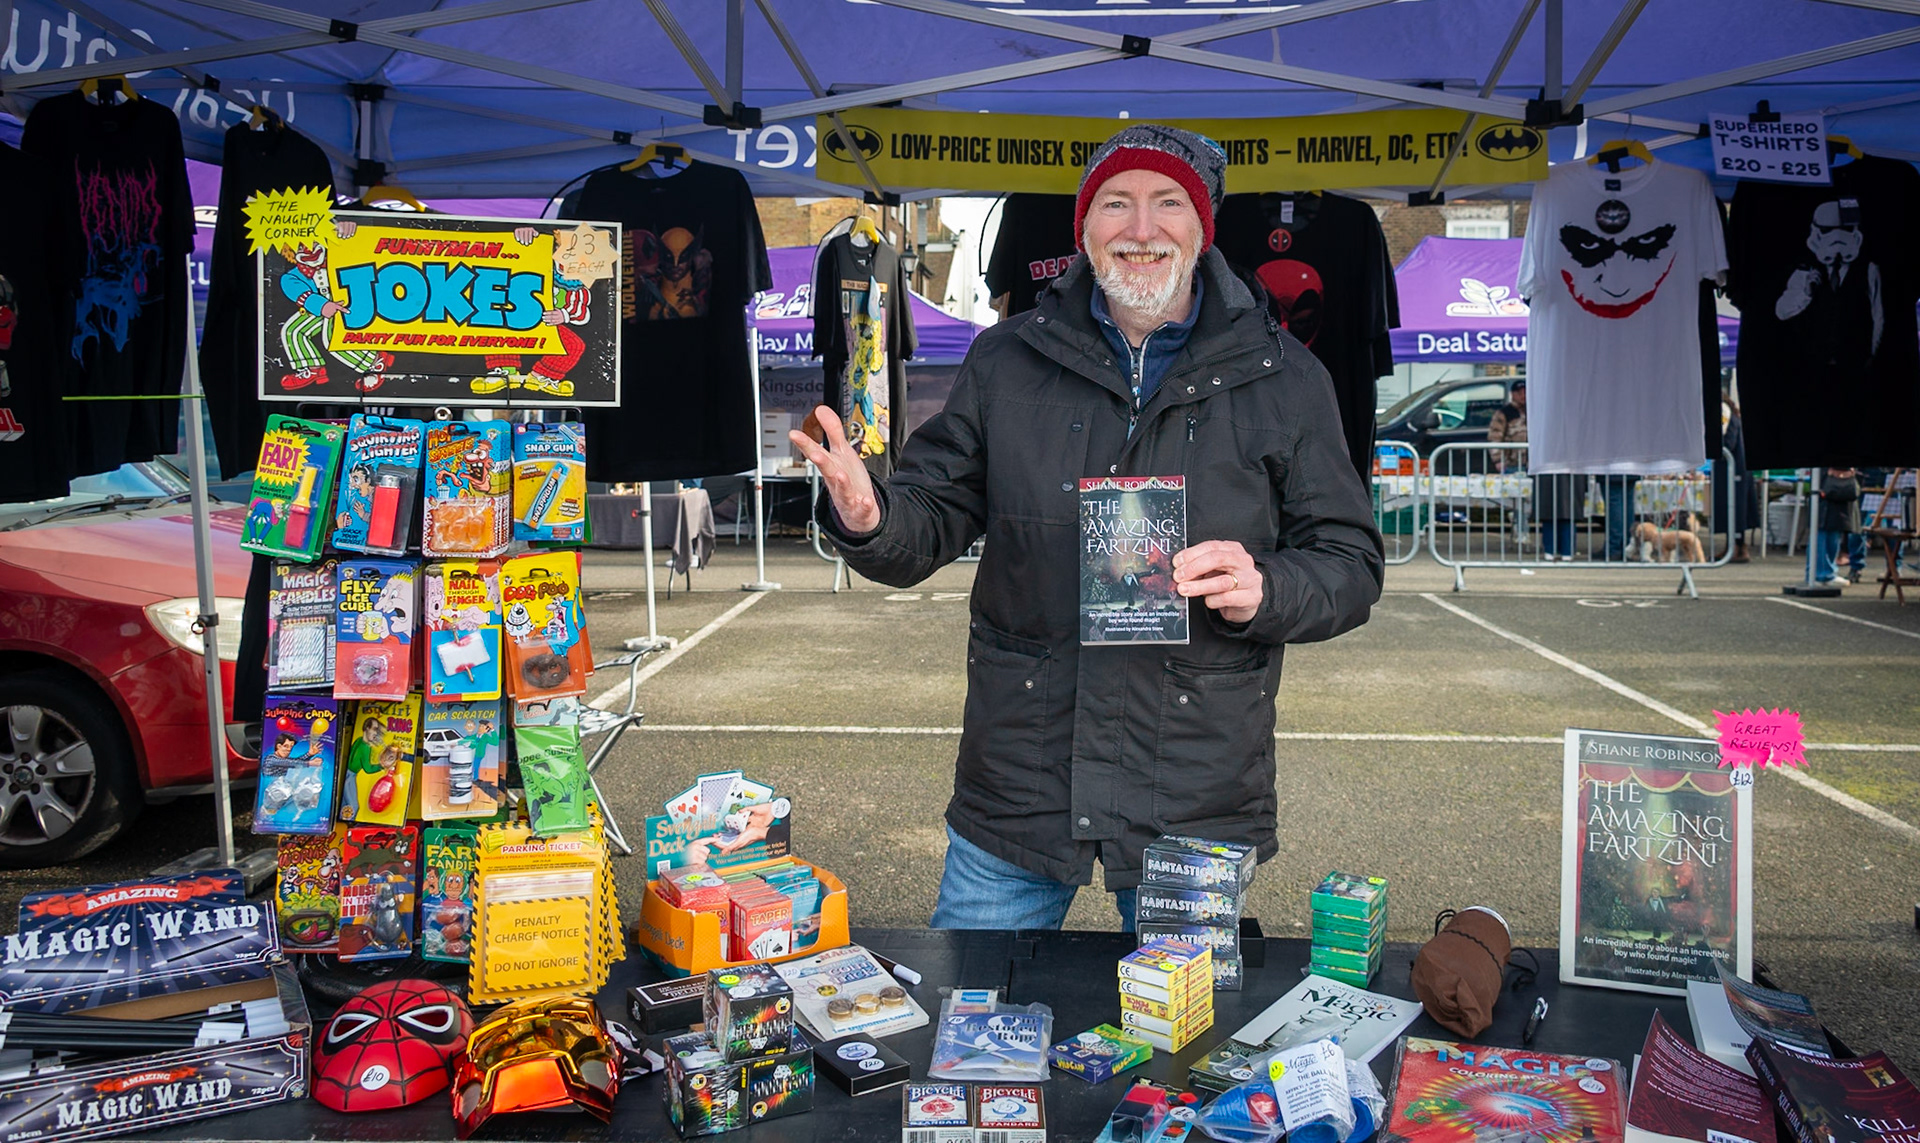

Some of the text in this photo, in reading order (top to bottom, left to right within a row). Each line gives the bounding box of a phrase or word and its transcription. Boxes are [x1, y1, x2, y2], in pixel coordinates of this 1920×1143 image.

[1714, 119, 1818, 134] SUPERHERO
[891, 133, 991, 163] LOW-PRICE
[997, 138, 1064, 166] UNISEX
[1297, 135, 1382, 165] MARVEL,
[1388, 134, 1419, 164] DC,
[1715, 133, 1820, 151] T-SHIRTS
[1721, 157, 1821, 176] £20 £25
[267, 201, 299, 212] THE
[260, 213, 326, 230] NAUGHTY
[265, 227, 319, 240] CORNER
[566, 261, 605, 274] EACH
[336, 262, 546, 331] JOKES
[342, 332, 537, 348] PARTY FUN FOR EVERYONE
[1417, 331, 1528, 354] Deal Satu
[276, 436, 293, 445] THE
[350, 427, 422, 452] SQUIRTING
[360, 443, 418, 461] LIGHTER
[428, 436, 475, 463] SWEETS
[525, 443, 575, 453] SNAP GUM
[261, 442, 303, 471] FART
[259, 466, 294, 479] WHISTLE
[1087, 480, 1179, 491] SHANE ROBINSON
[1084, 500, 1122, 515] THE
[1085, 517, 1181, 537] AMAZING
[1086, 537, 1171, 556] FARTZINI
[282, 571, 332, 589] MAGIC
[340, 579, 377, 594] FLY
[449, 579, 480, 590] NAIL
[277, 586, 337, 605] CANDLES
[346, 593, 370, 603] ICE
[503, 584, 538, 602] DOG
[538, 582, 570, 600] POO
[339, 602, 374, 612] CUBE
[446, 594, 486, 606] FINGER
[427, 710, 497, 722] CAR SCRATCH
[1734, 722, 1781, 735] GREAT
[1590, 742, 1641, 758] SHANE
[1730, 738, 1798, 756] REVIEWS!
[1732, 771, 1753, 786] £12
[1585, 778, 1643, 803] THE
[1587, 804, 1733, 843] AMAZING
[426, 845, 476, 860] FAR
[501, 842, 583, 853] PARKING TICKET
[649, 837, 686, 857] Deck
[1588, 832, 1718, 868] FARTZINI
[427, 858, 475, 871] CANDIE
[342, 884, 377, 897] MOUSE
[86, 887, 180, 911] AMAZING
[342, 897, 352, 905] IN
[342, 905, 371, 917] HOUS
[750, 907, 789, 926] TAPER
[514, 916, 561, 927] PENALTY
[1, 905, 261, 965] MAGIC WAND
[494, 928, 580, 944] CHARGE NOTICE
[1583, 936, 1594, 944] An
[1595, 936, 1633, 949] incredible
[1634, 941, 1654, 952] story
[1655, 943, 1678, 954] about
[1690, 947, 1730, 959] incredible
[494, 956, 579, 973] DO NOT IGNORE
[1613, 948, 1698, 965] boy who found magic!
[1624, 966, 1661, 977] Illustrated
[1661, 969, 1671, 978] by
[1437, 1048, 1595, 1080] MAGIC
[122, 1073, 171, 1089] AMAZING
[362, 1070, 385, 1083] £10
[1311, 1069, 1327, 1077] BALL
[1449, 1067, 1519, 1080] COLORING
[911, 1086, 965, 1101] BICYCLE
[982, 1088, 1037, 1103] BICYCLE
[56, 1077, 233, 1129] MAGIC WAND
